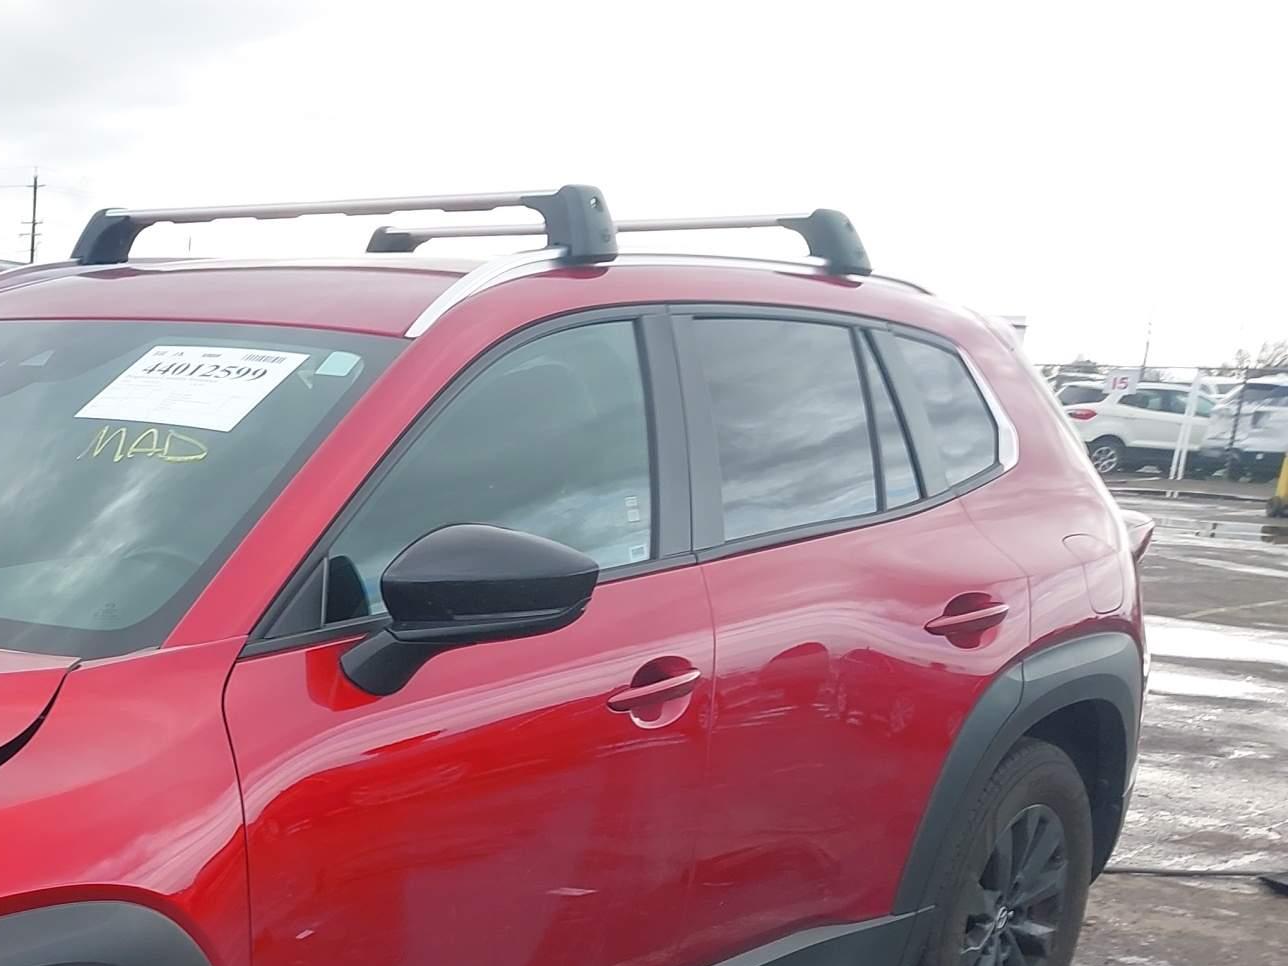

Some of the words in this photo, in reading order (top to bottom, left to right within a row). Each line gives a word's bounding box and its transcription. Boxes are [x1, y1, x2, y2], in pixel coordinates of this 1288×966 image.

[143, 362, 268, 382] 44012599
[1112, 376, 1129, 390] 15
[76, 425, 208, 463] MAD
